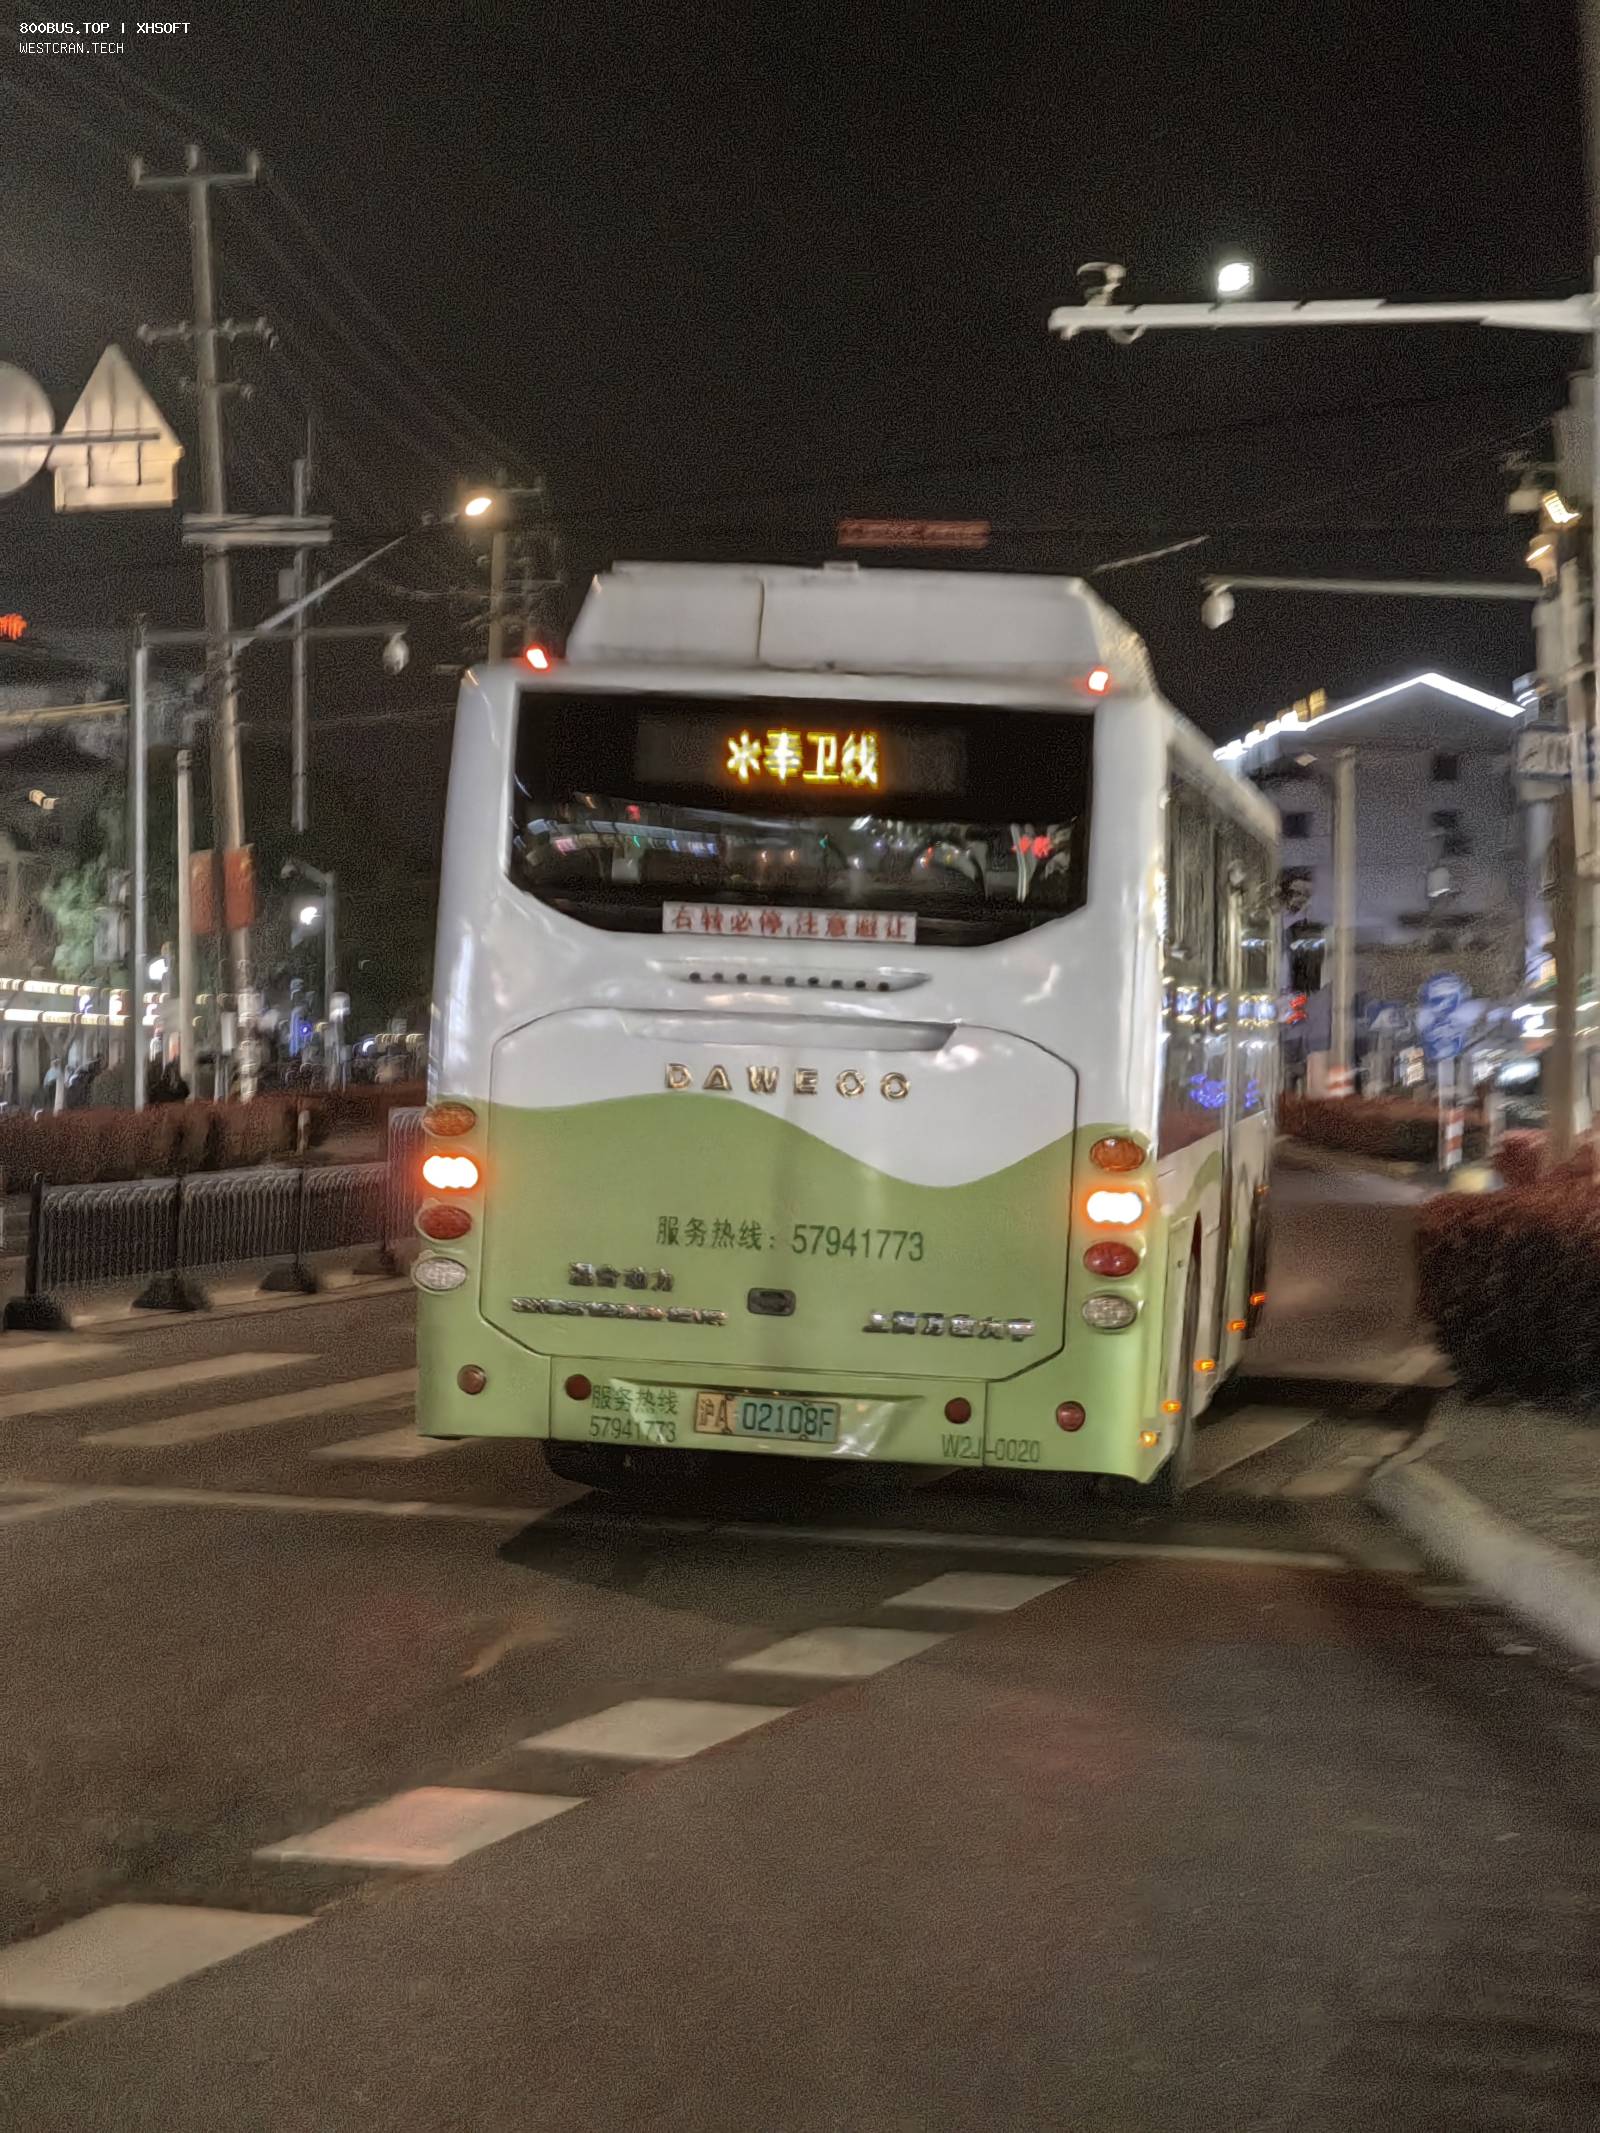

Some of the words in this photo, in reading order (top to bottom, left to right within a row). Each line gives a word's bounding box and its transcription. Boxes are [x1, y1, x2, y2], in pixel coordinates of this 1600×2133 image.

[791, 1224, 924, 1263] 57941773
[591, 1384, 679, 1416] 服务热线
[588, 1415, 677, 1443] 57941773
